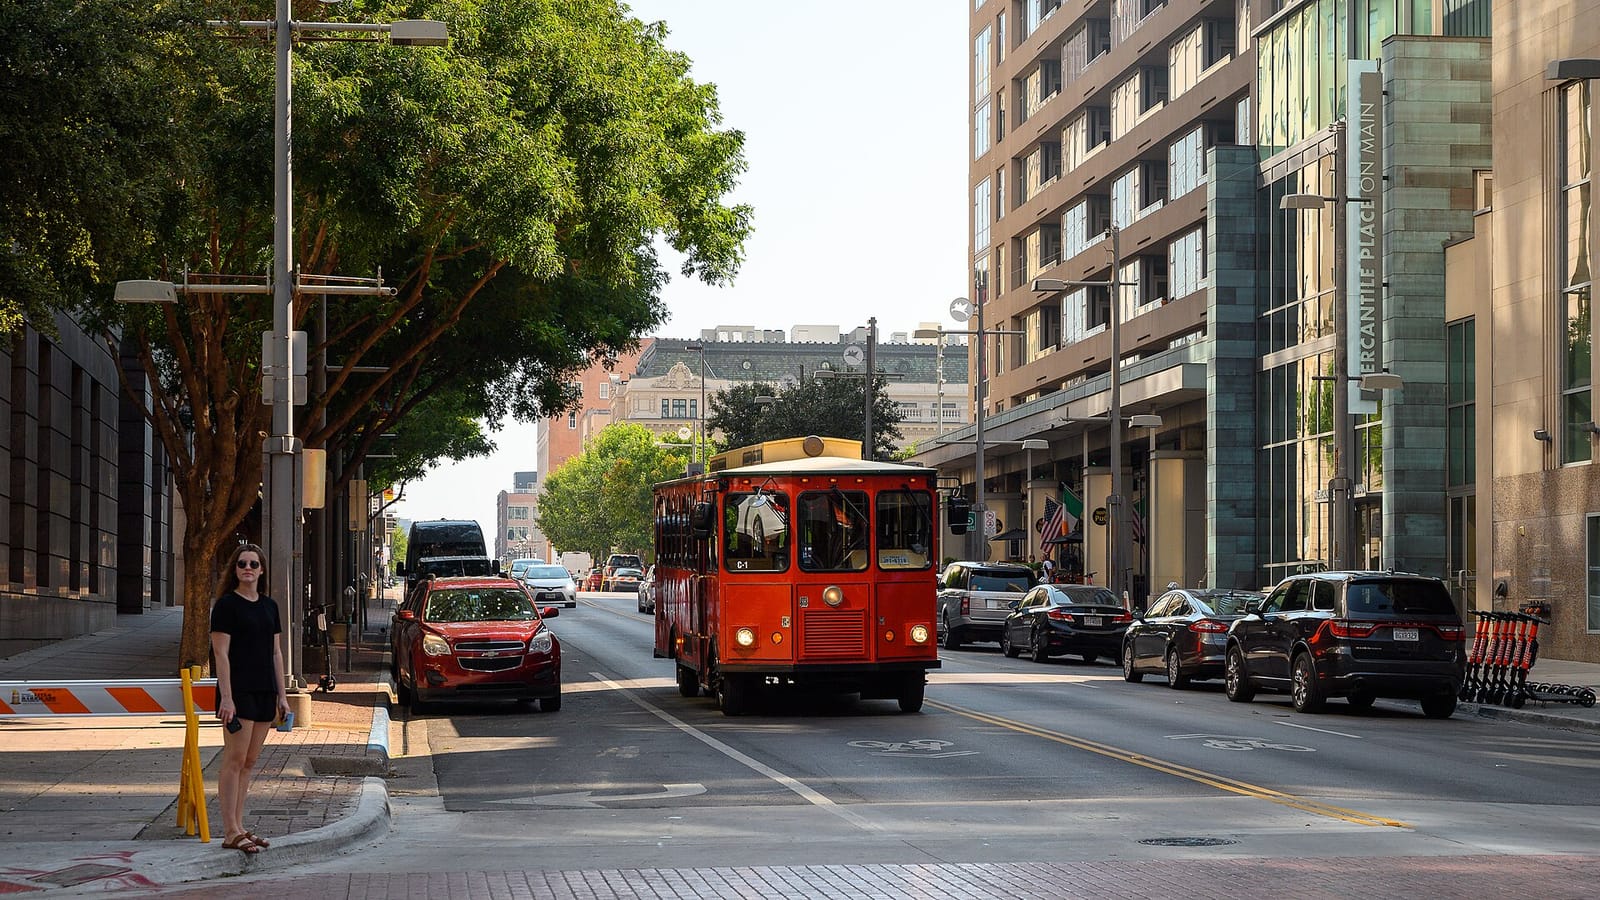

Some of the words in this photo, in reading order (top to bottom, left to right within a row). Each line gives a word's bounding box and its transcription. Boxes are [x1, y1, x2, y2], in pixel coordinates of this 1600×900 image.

[1361, 103, 1375, 154] MAIN
[1361, 162, 1375, 193] ON
[1360, 199, 1375, 259] PLACE
[1361, 268, 1375, 374] ERCANTILE
[737, 560, 748, 569] C-1
